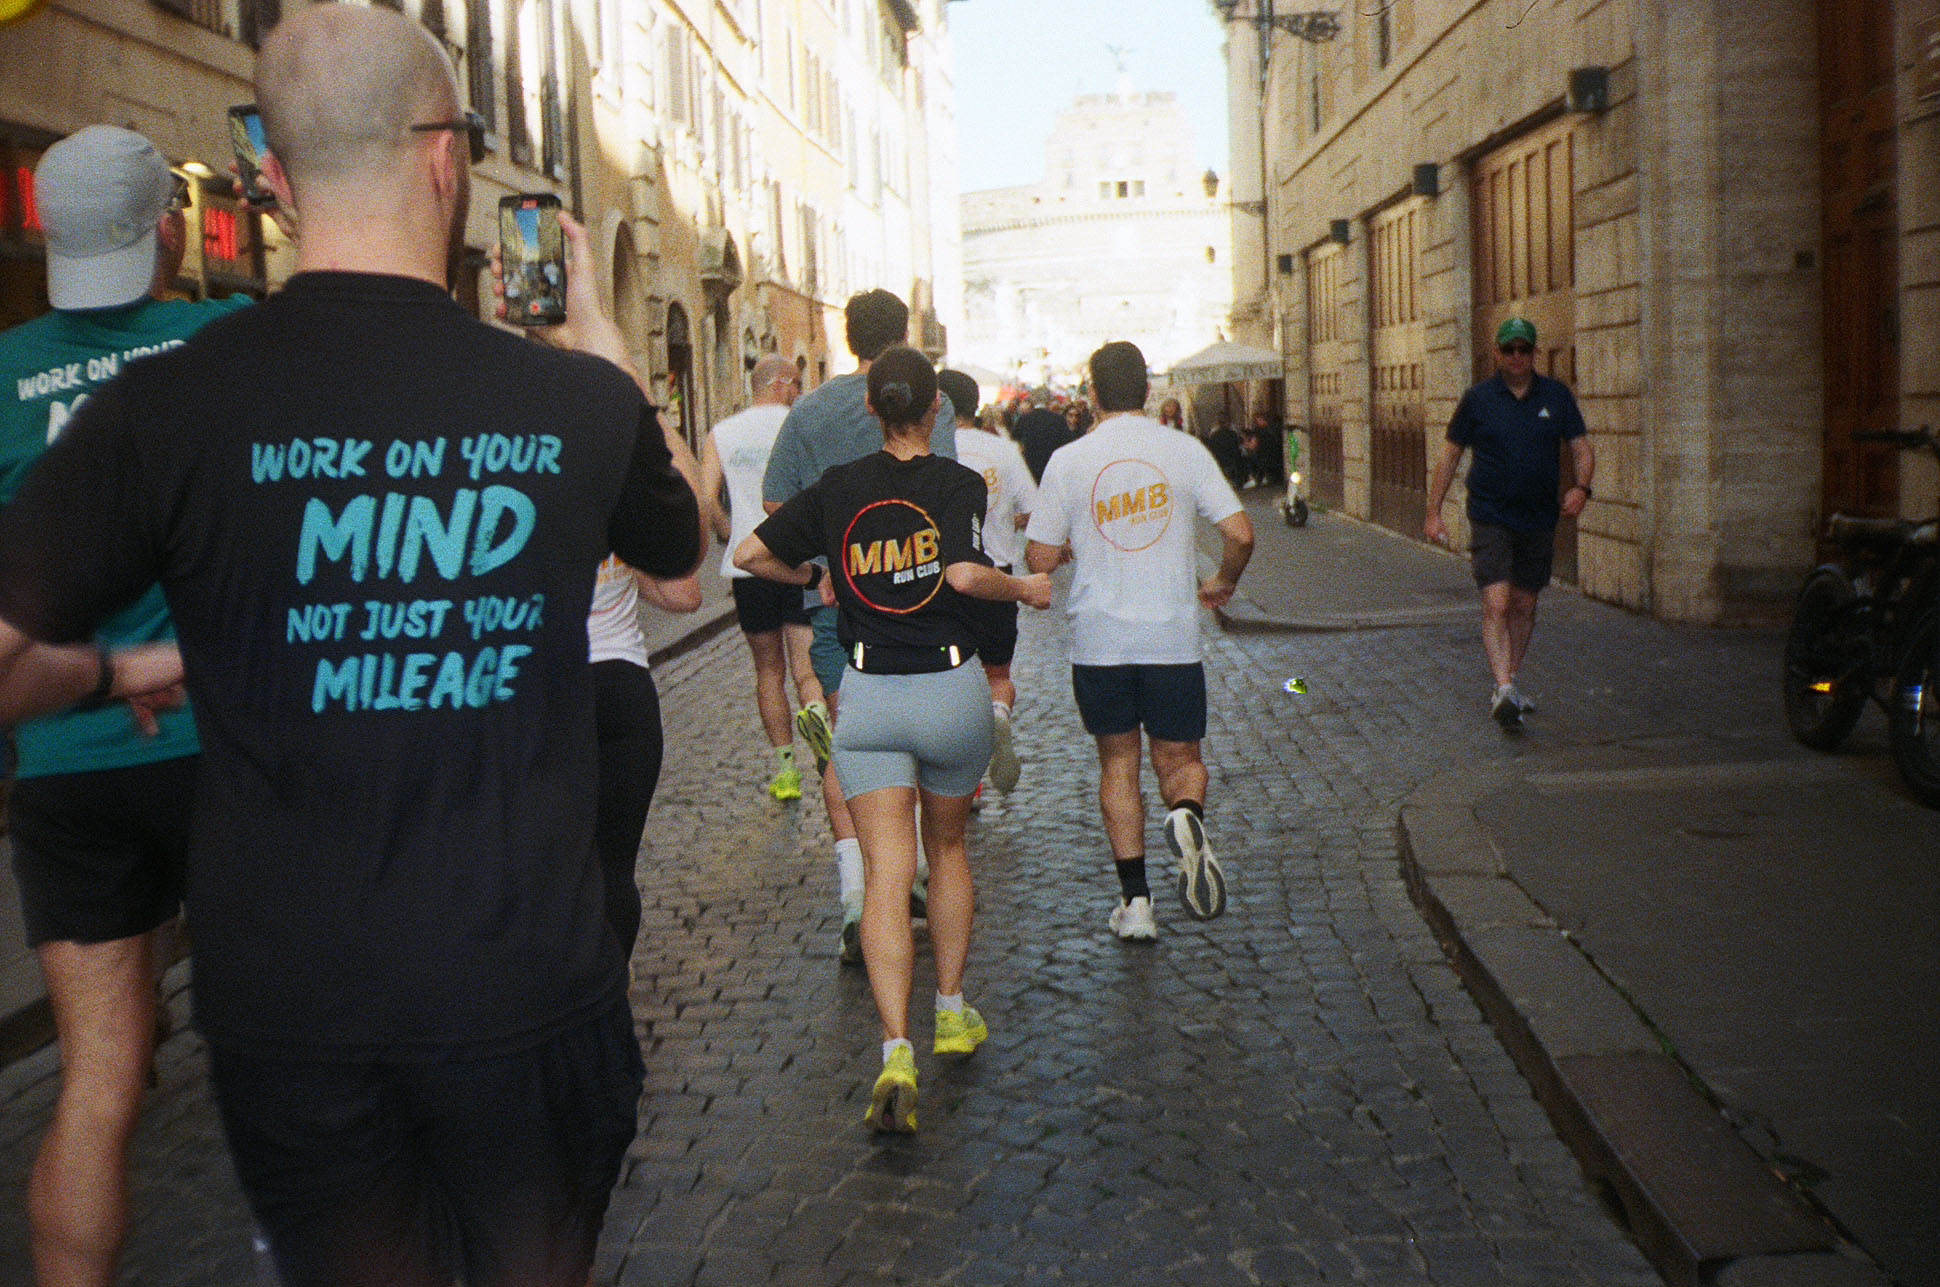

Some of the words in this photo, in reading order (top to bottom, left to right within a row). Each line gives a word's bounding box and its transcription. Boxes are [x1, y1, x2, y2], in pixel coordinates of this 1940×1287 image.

[17, 363, 84, 401] WORK
[87, 353, 118, 381] ON
[252, 437, 373, 483] WORK
[385, 437, 447, 479] ON
[461, 433, 563, 480] YOUR
[1097, 483, 1169, 526] MMB
[296, 485, 537, 585] MIND
[850, 528, 938, 576] MMB
[894, 568, 915, 584] RUN
[916, 561, 941, 578] CLUB
[287, 603, 353, 644] NOT
[359, 599, 453, 640] JUST
[312, 645, 533, 713] MILEAGE
